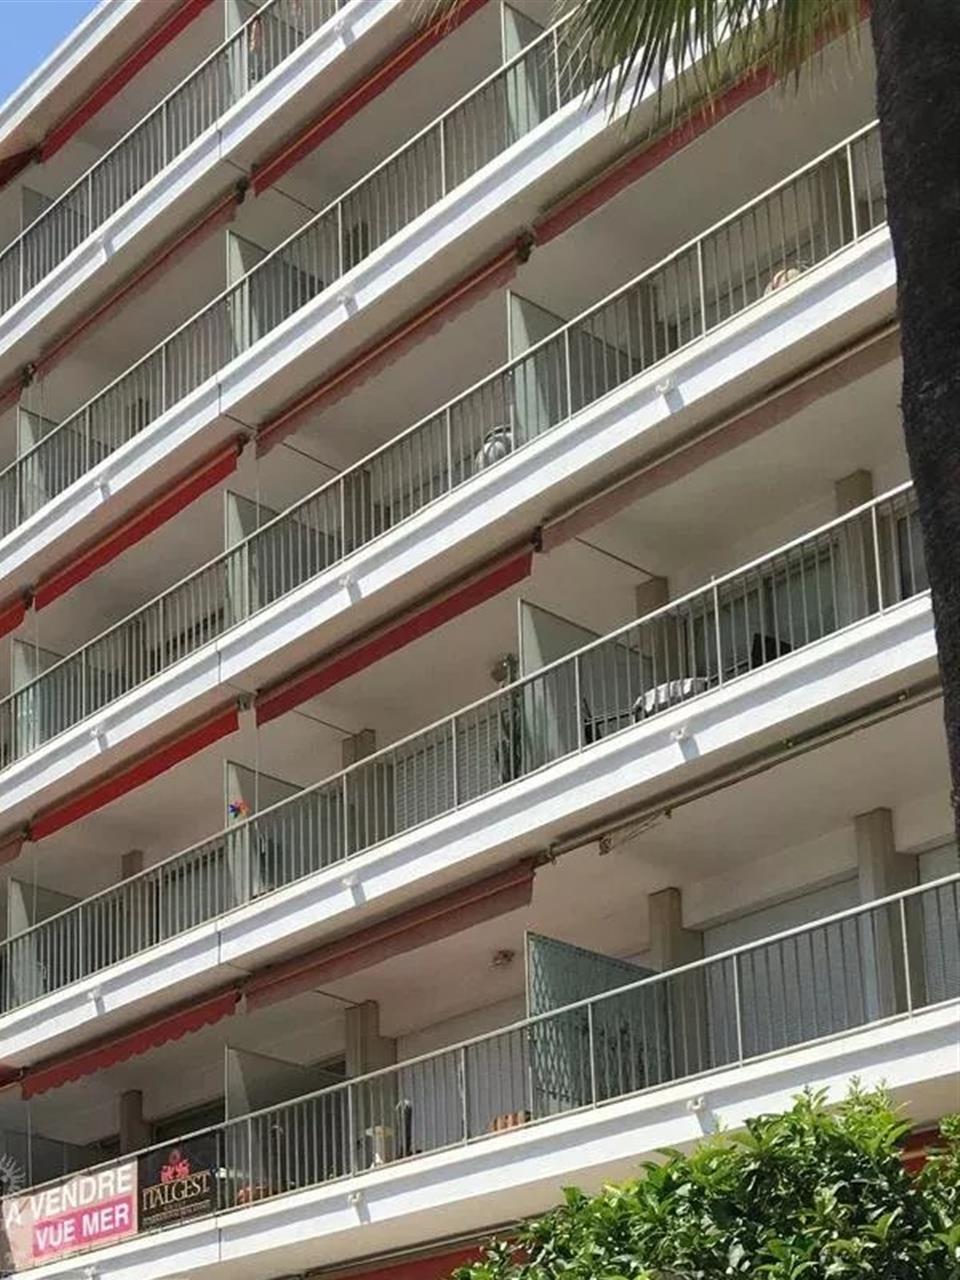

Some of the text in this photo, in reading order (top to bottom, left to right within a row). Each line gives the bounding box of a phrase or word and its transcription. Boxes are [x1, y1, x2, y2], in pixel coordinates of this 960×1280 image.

[30, 1163, 132, 1218] VENDRE
[142, 1171, 211, 1210] ITALGEST
[36, 1218, 76, 1250] VUE
[82, 1202, 130, 1237] MER
